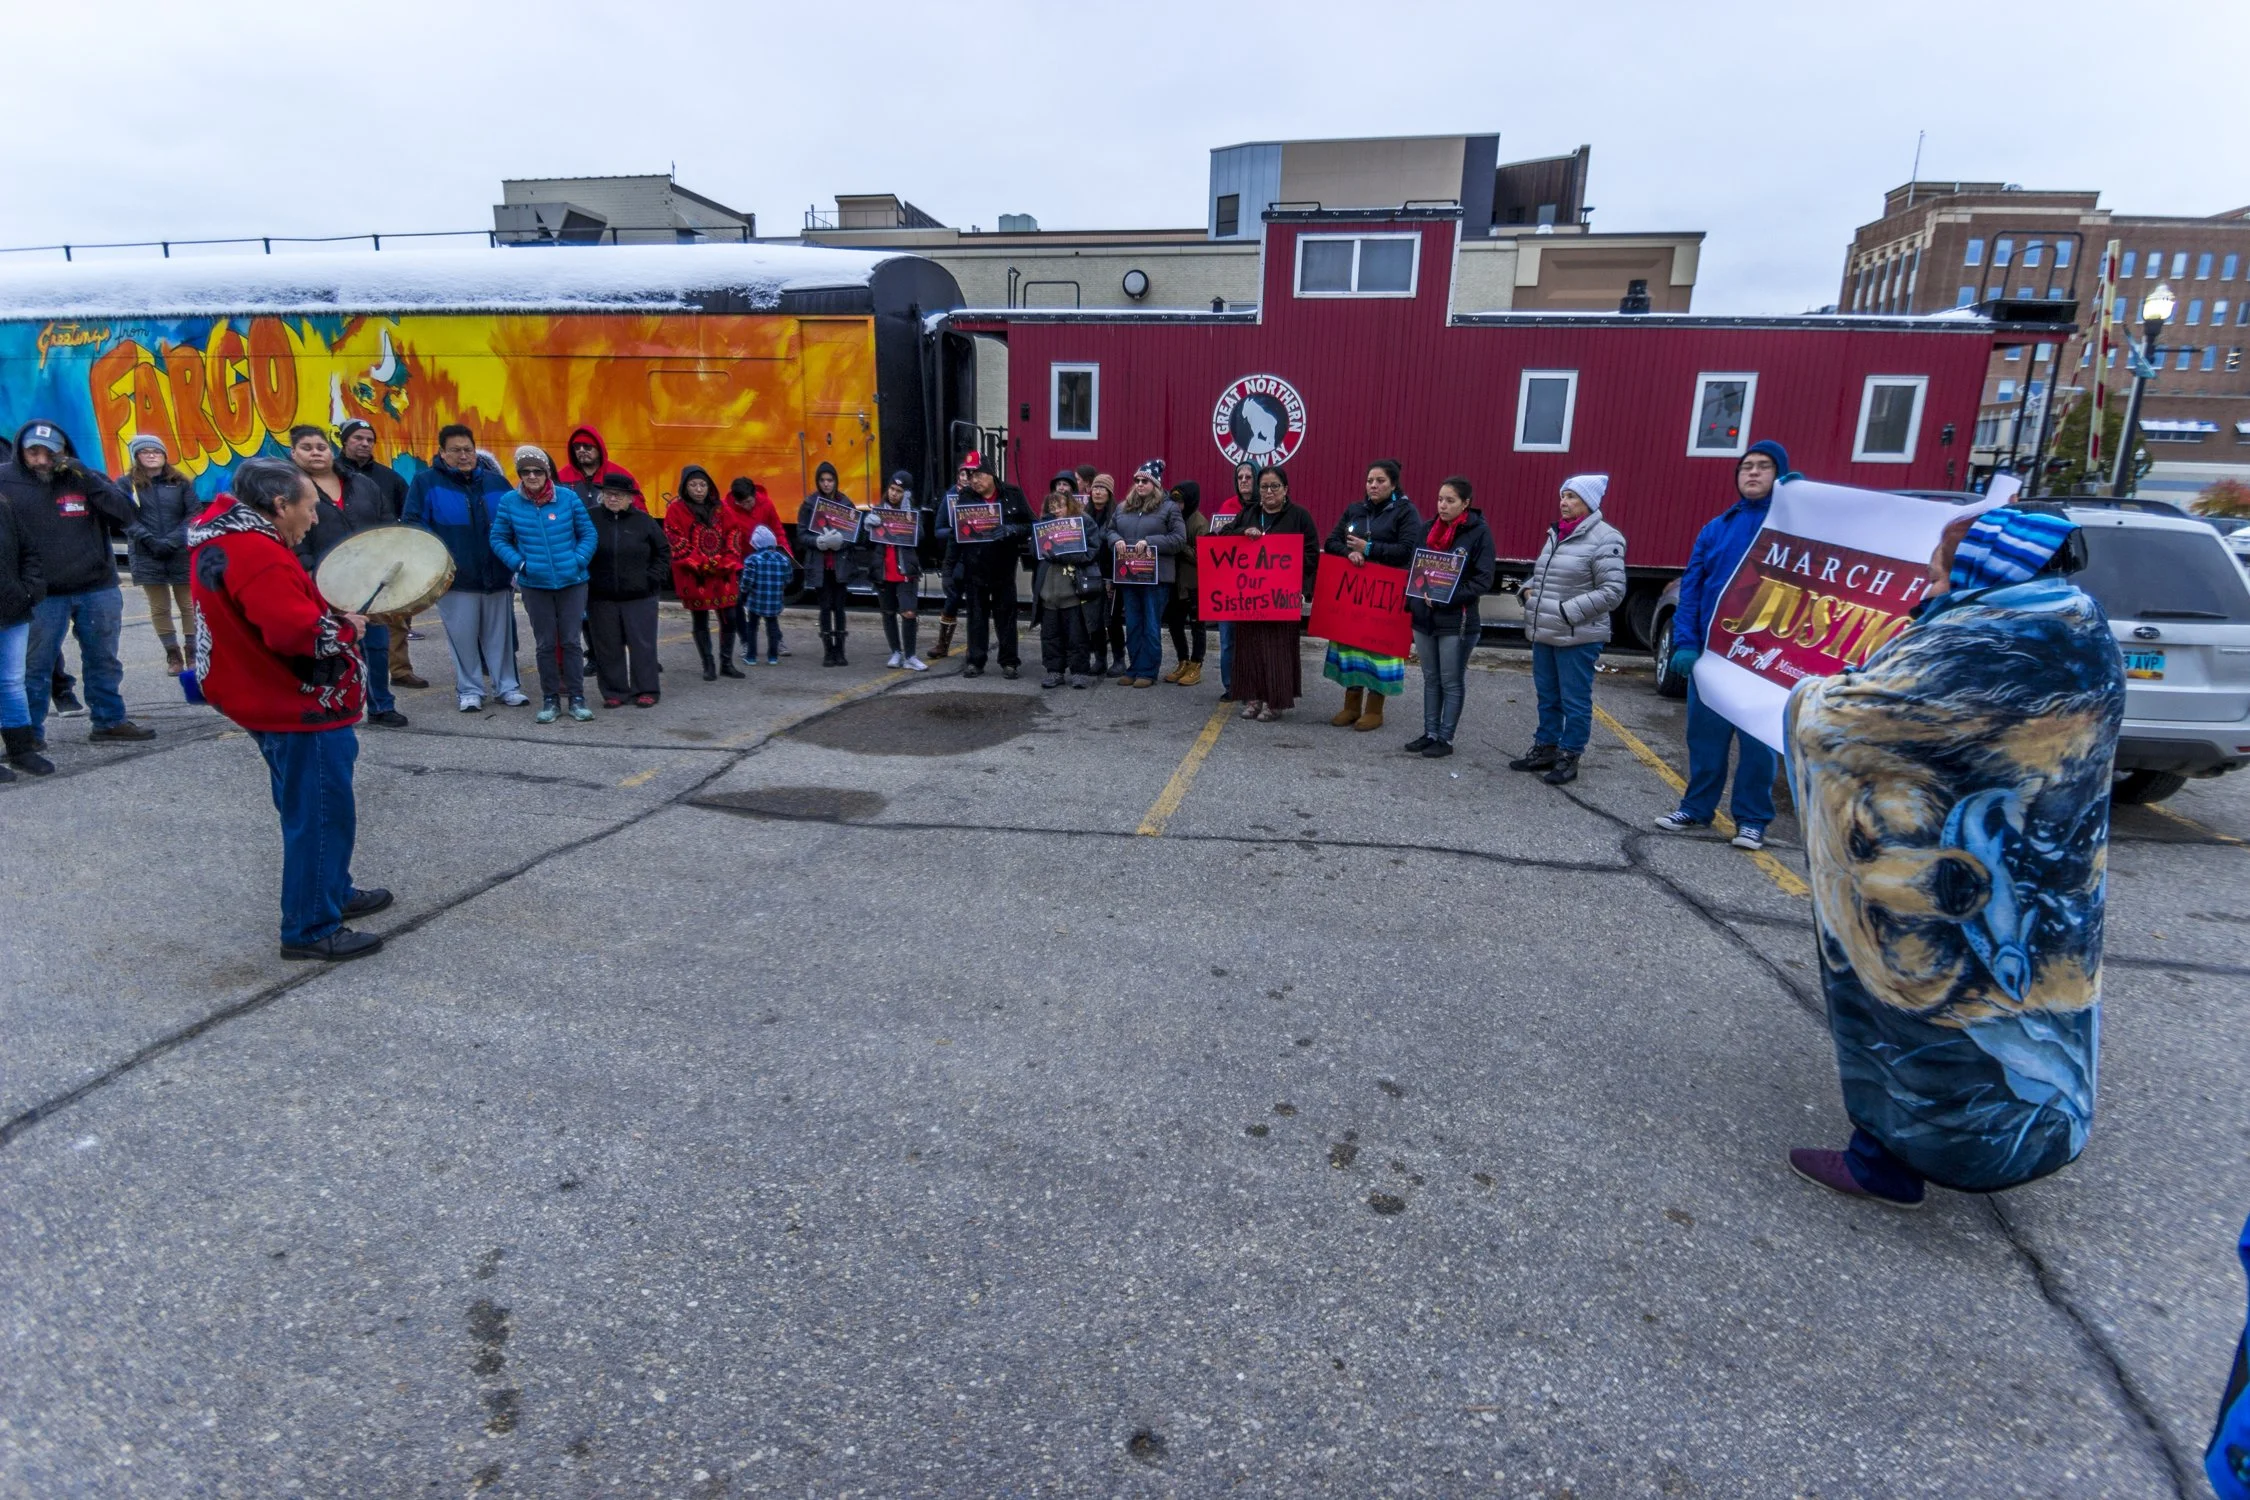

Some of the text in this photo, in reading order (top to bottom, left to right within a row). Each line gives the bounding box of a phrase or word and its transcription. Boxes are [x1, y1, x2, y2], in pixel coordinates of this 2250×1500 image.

[37, 319, 150, 369] Greetings from
[89, 316, 299, 480] FARGO
[1216, 378, 1302, 435] GREAT NORTHERN
[1225, 441, 1289, 467] RAIWAY
[1210, 545, 1292, 571] We Are
[1417, 552, 1437, 560] MARCH
[1761, 542, 1895, 596] MARCH
[1236, 572, 1267, 590] Our
[1210, 590, 1270, 613] Sisters
[1720, 575, 1914, 666] JUSTIC
[1726, 635, 1755, 659] for
[1752, 647, 1783, 670] All
[2134, 656, 2160, 671] AVP
